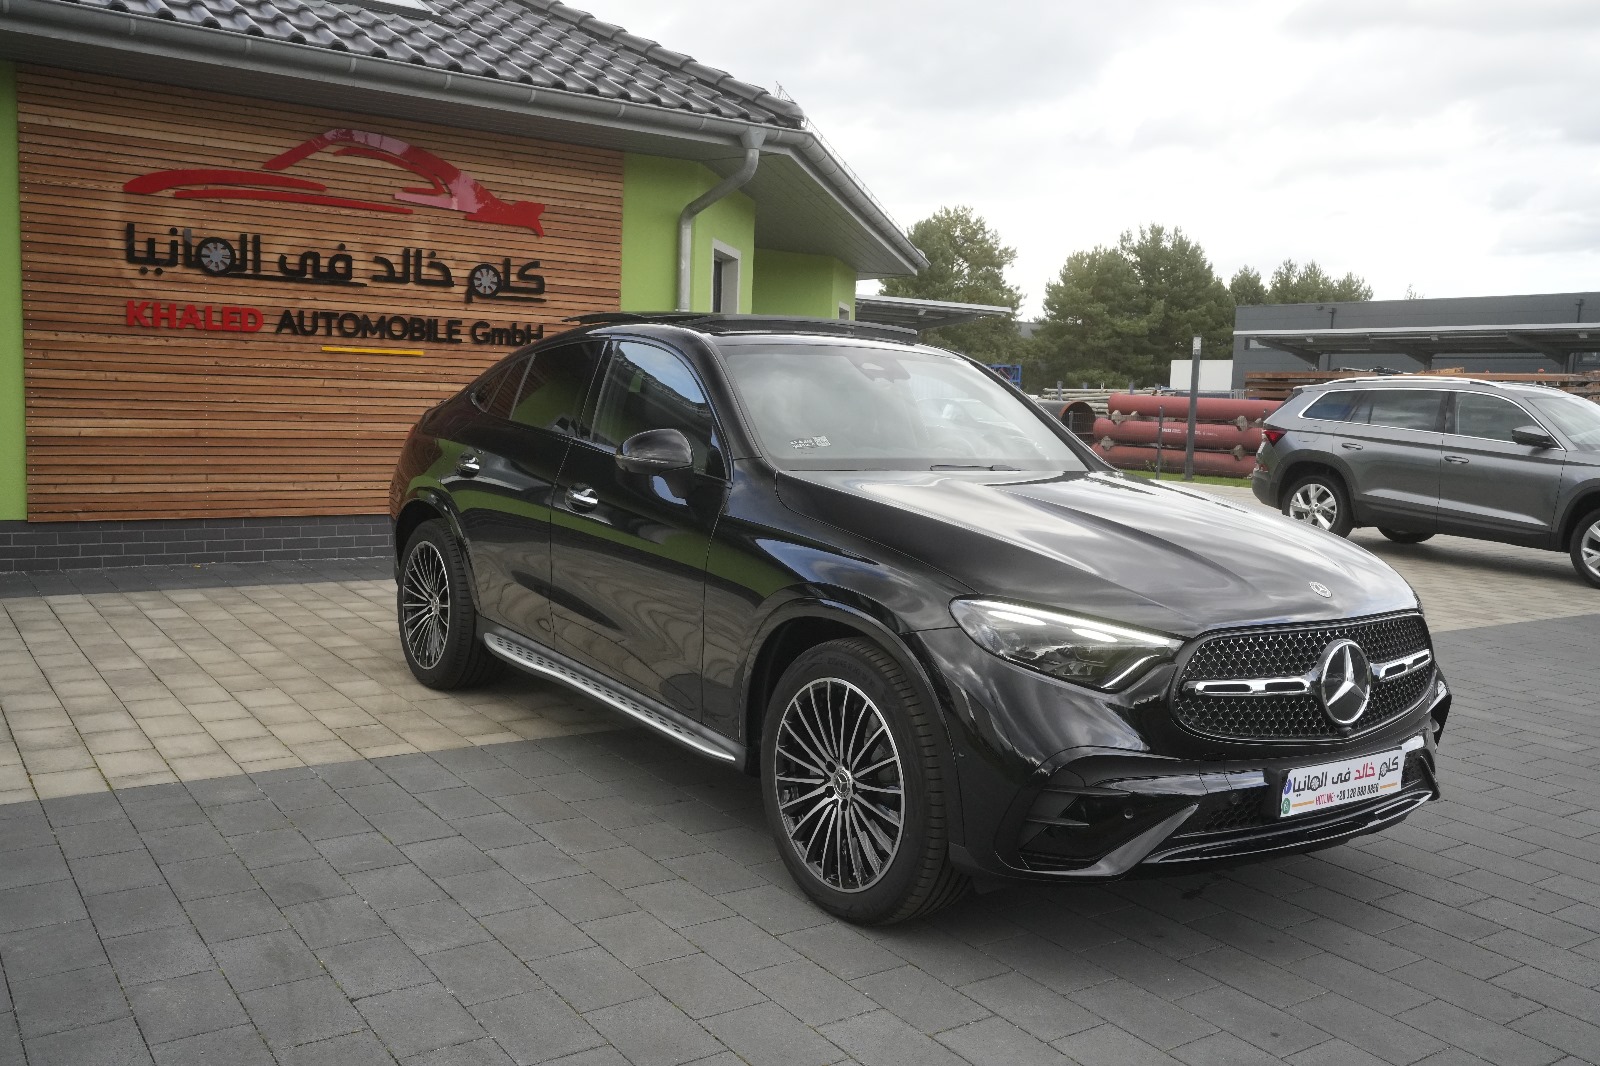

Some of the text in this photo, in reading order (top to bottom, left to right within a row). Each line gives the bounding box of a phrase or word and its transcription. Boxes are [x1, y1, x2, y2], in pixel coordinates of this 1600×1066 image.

[126, 222, 261, 277] المانيا
[371, 247, 455, 287] خالد
[126, 300, 544, 346] KHALED AUTOMOBILE GmbH
[1354, 762, 1375, 780] خالد
